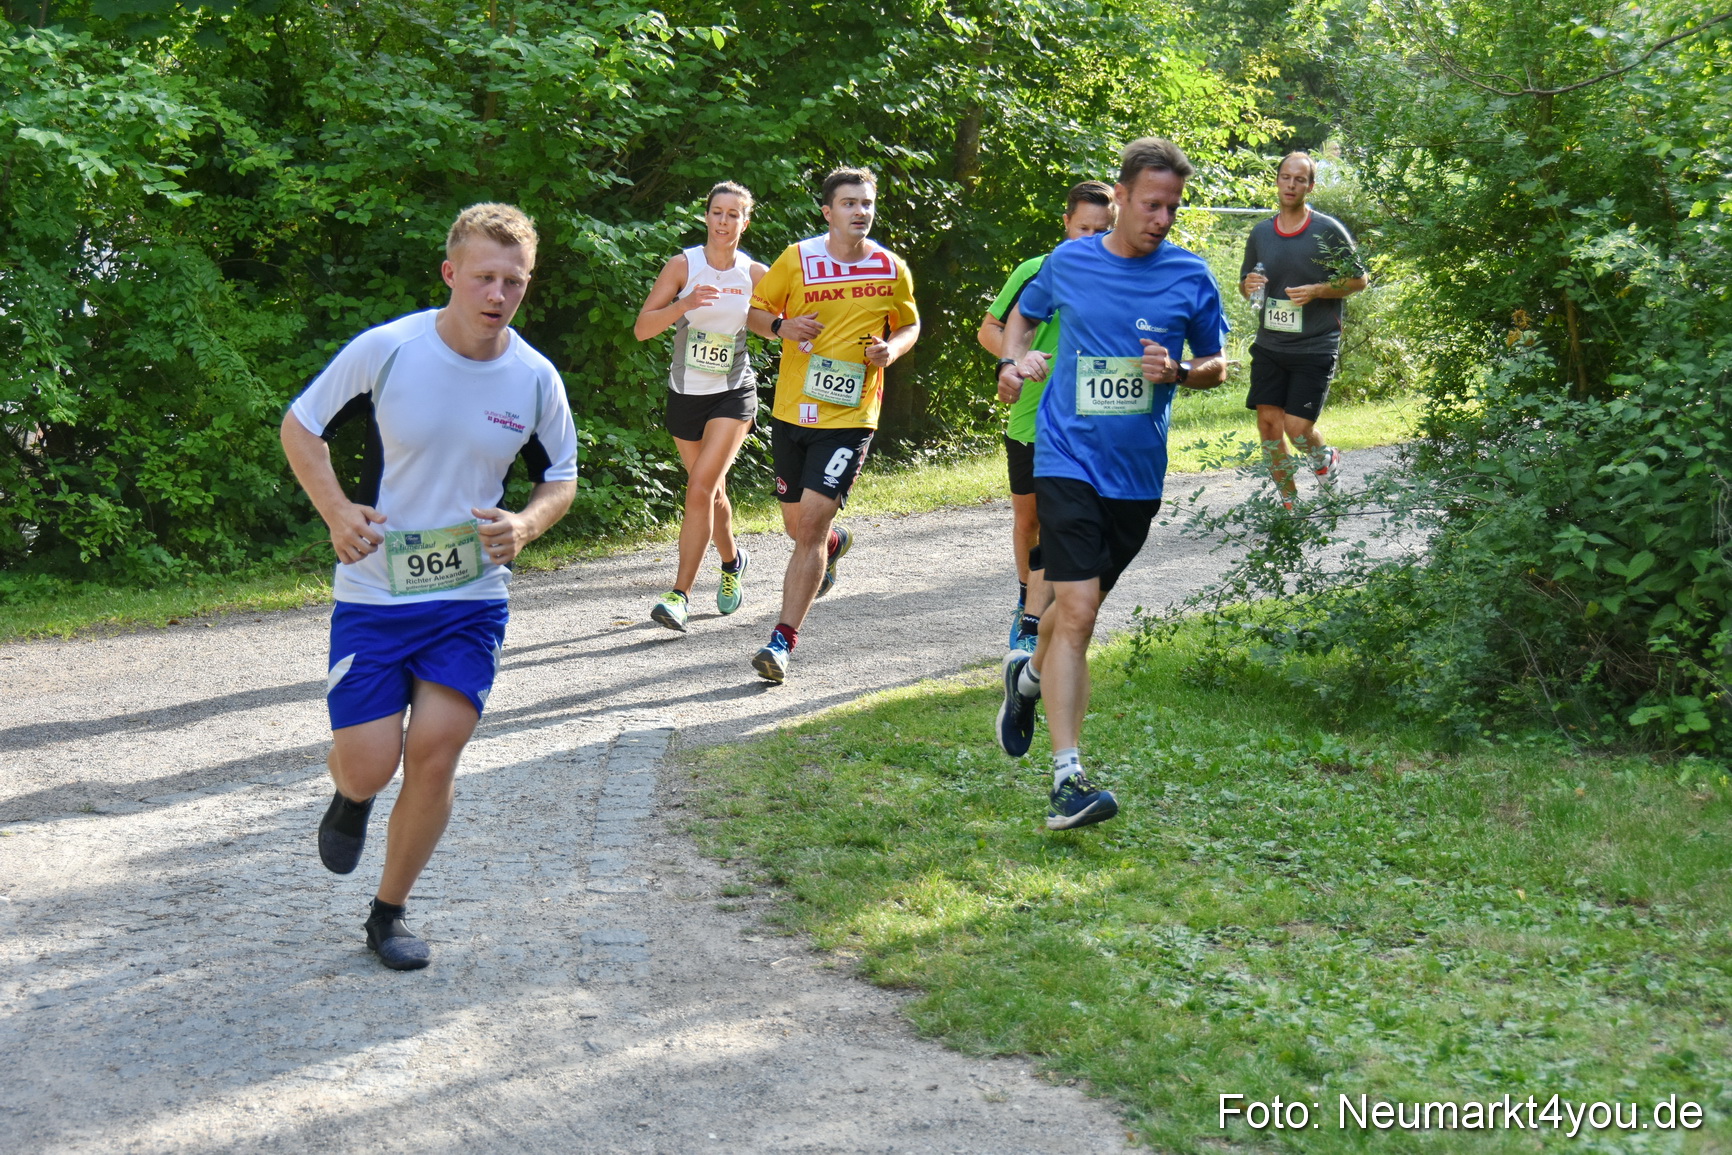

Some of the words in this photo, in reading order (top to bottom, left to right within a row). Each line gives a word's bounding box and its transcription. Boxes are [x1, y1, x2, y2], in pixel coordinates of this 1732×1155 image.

[719, 287, 744, 295] EBL
[804, 288, 845, 304] MAX
[851, 283, 894, 298] BÖGL
[1268, 309, 1295, 323] 1481
[692, 343, 728, 363] 1156
[813, 371, 856, 394] 1629
[1086, 378, 1143, 399] 1068
[830, 391, 853, 399] Alexander
[493, 417, 526, 430] partner
[505, 411, 520, 419] TEAM
[824, 446, 854, 478] 6
[407, 547, 462, 577] 964
[405, 577, 432, 585] Richter
[433, 568, 469, 582] Alexander
